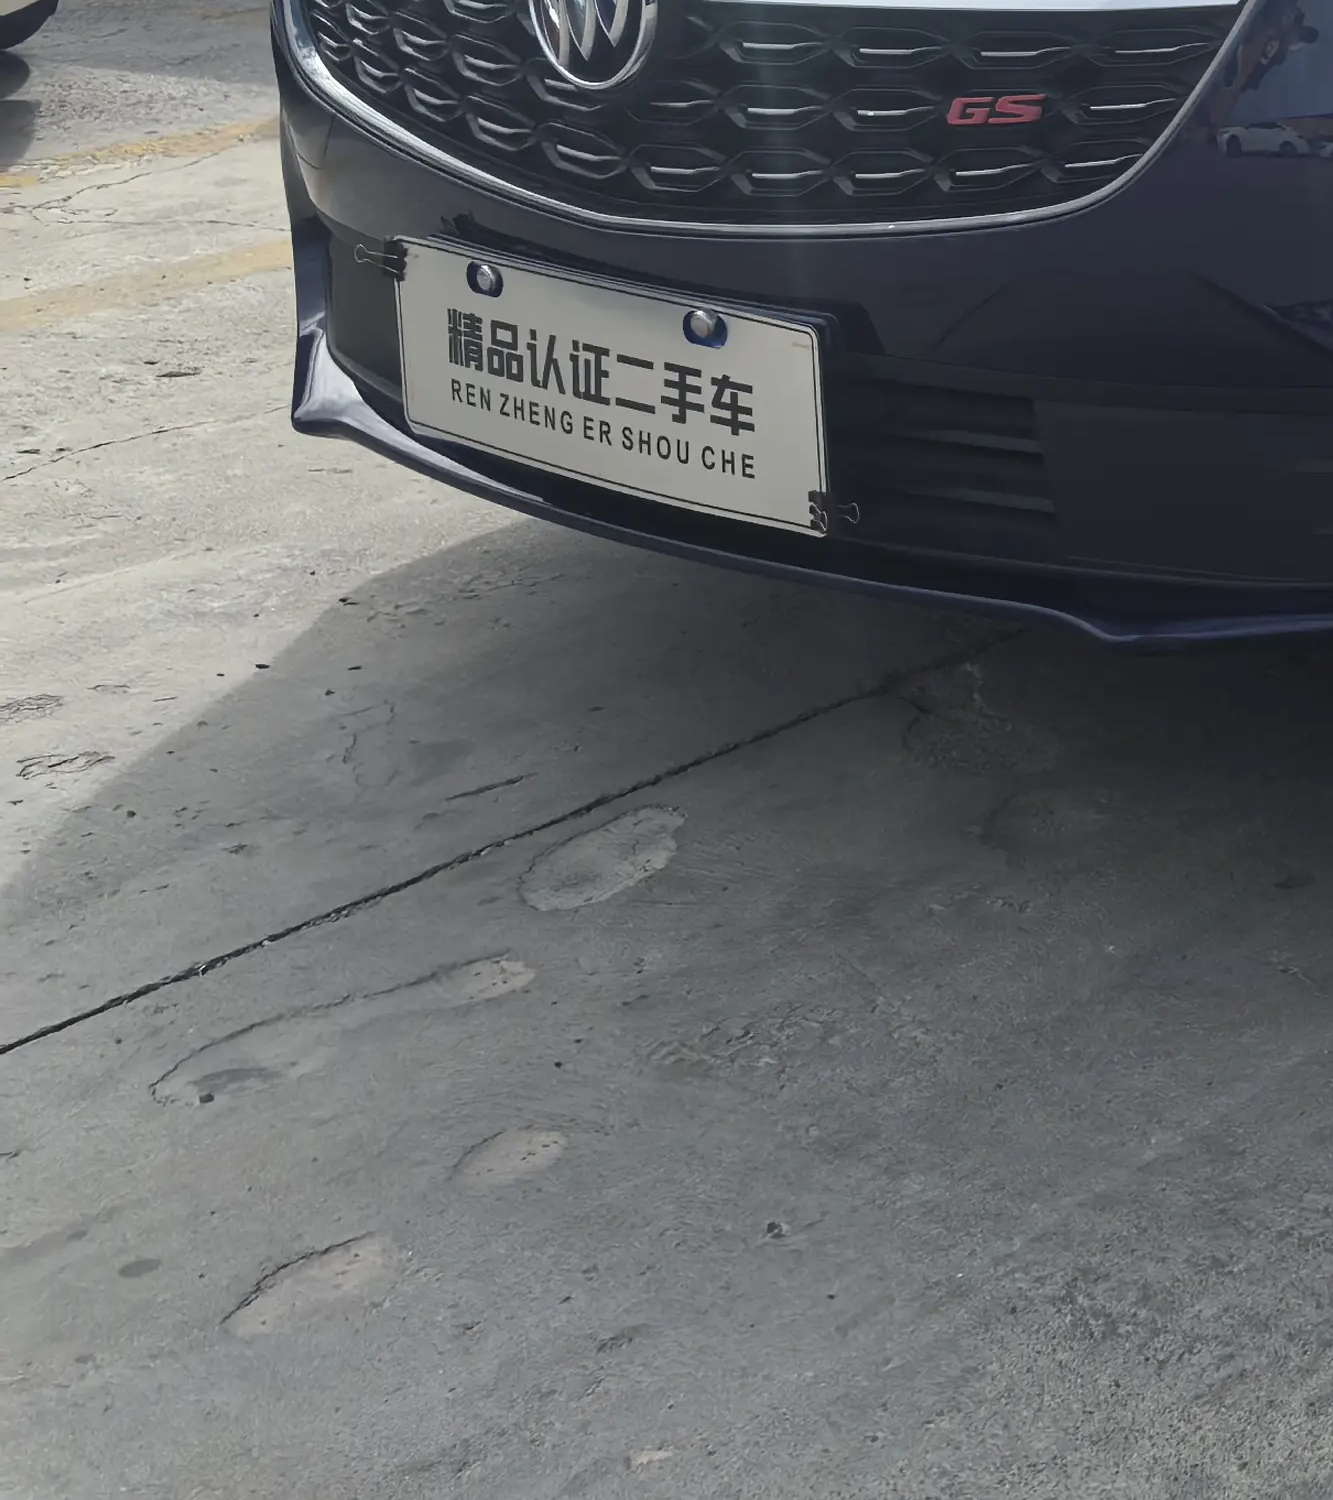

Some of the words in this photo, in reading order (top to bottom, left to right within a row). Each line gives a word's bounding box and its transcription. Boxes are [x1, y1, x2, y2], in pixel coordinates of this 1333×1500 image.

[947, 93, 1047, 125] GS
[446, 307, 756, 437] 精品认证二手车
[451, 378, 491, 412] REN
[499, 392, 574, 436] ZHENG
[583, 416, 613, 447] ER
[622, 426, 690, 465] SHOU
[702, 445, 756, 480] CHE
